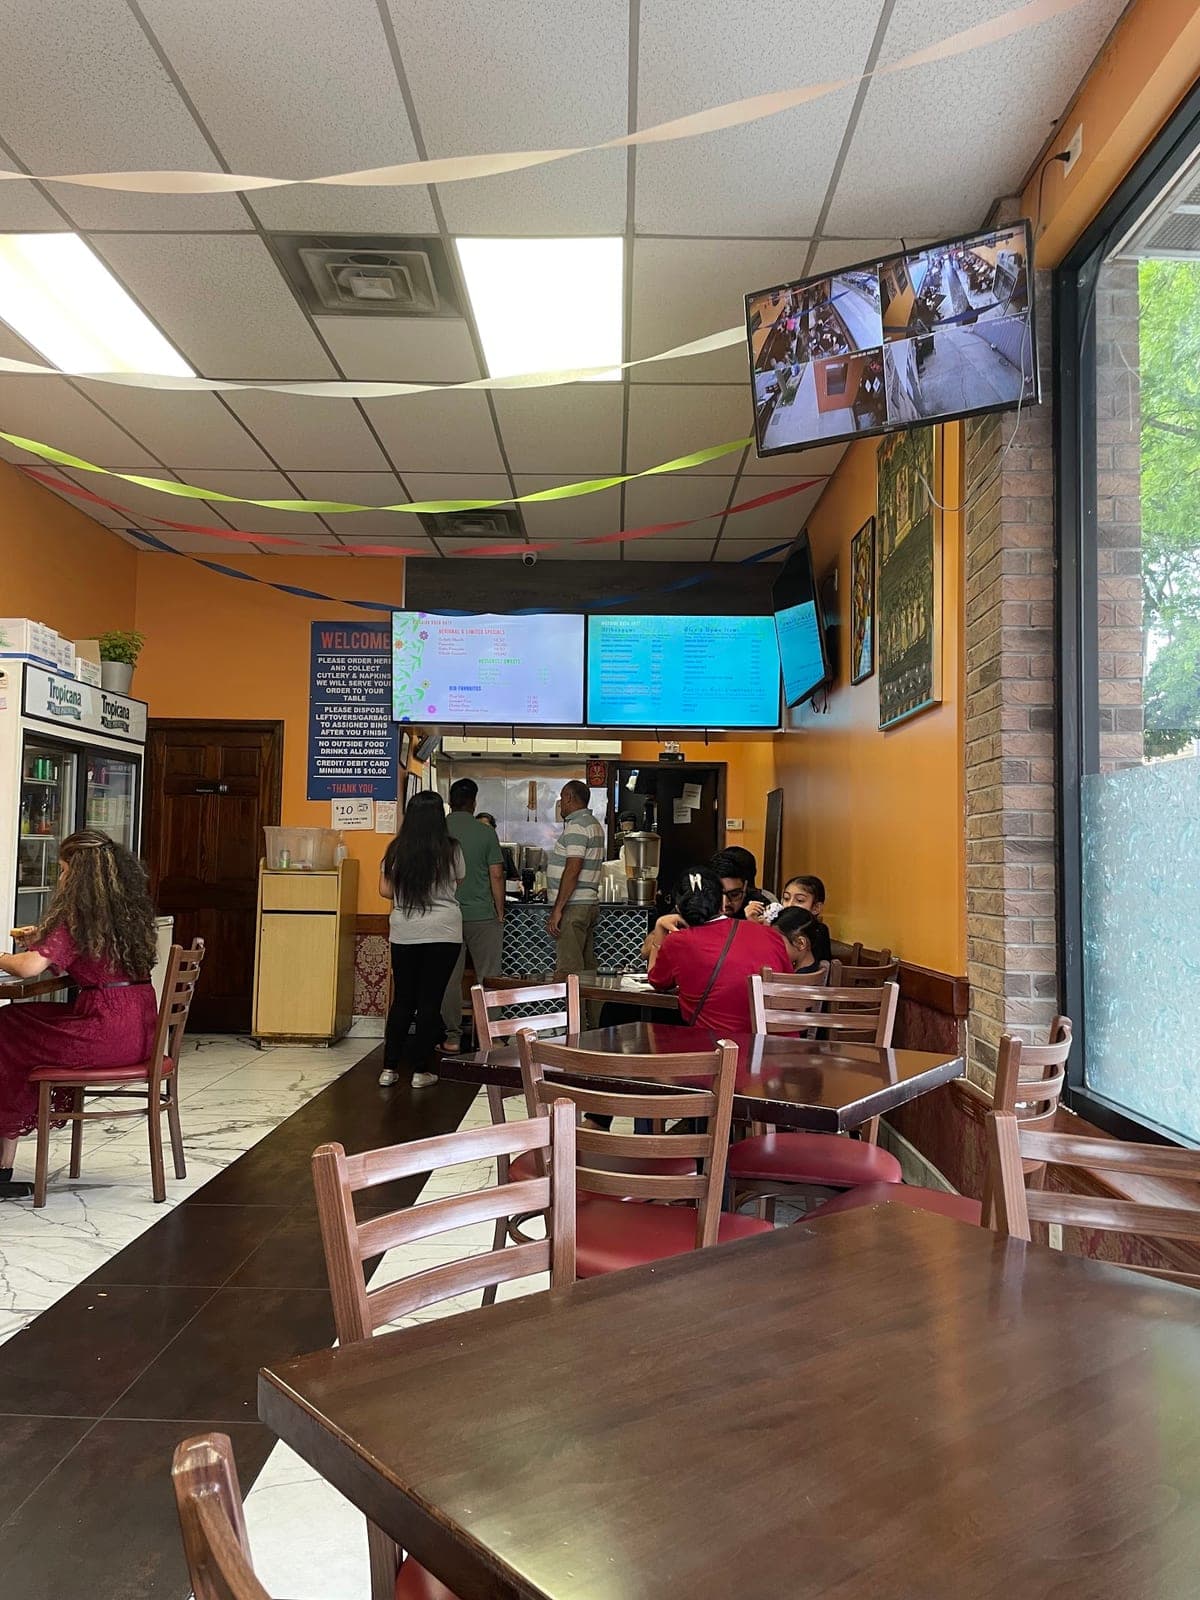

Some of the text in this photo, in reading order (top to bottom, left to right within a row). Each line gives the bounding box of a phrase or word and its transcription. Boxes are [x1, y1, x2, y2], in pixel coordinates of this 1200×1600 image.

[321, 631, 391, 649] WELCOME
[48, 676, 82, 707] Tropicana
[101, 694, 130, 720] Tropicana
